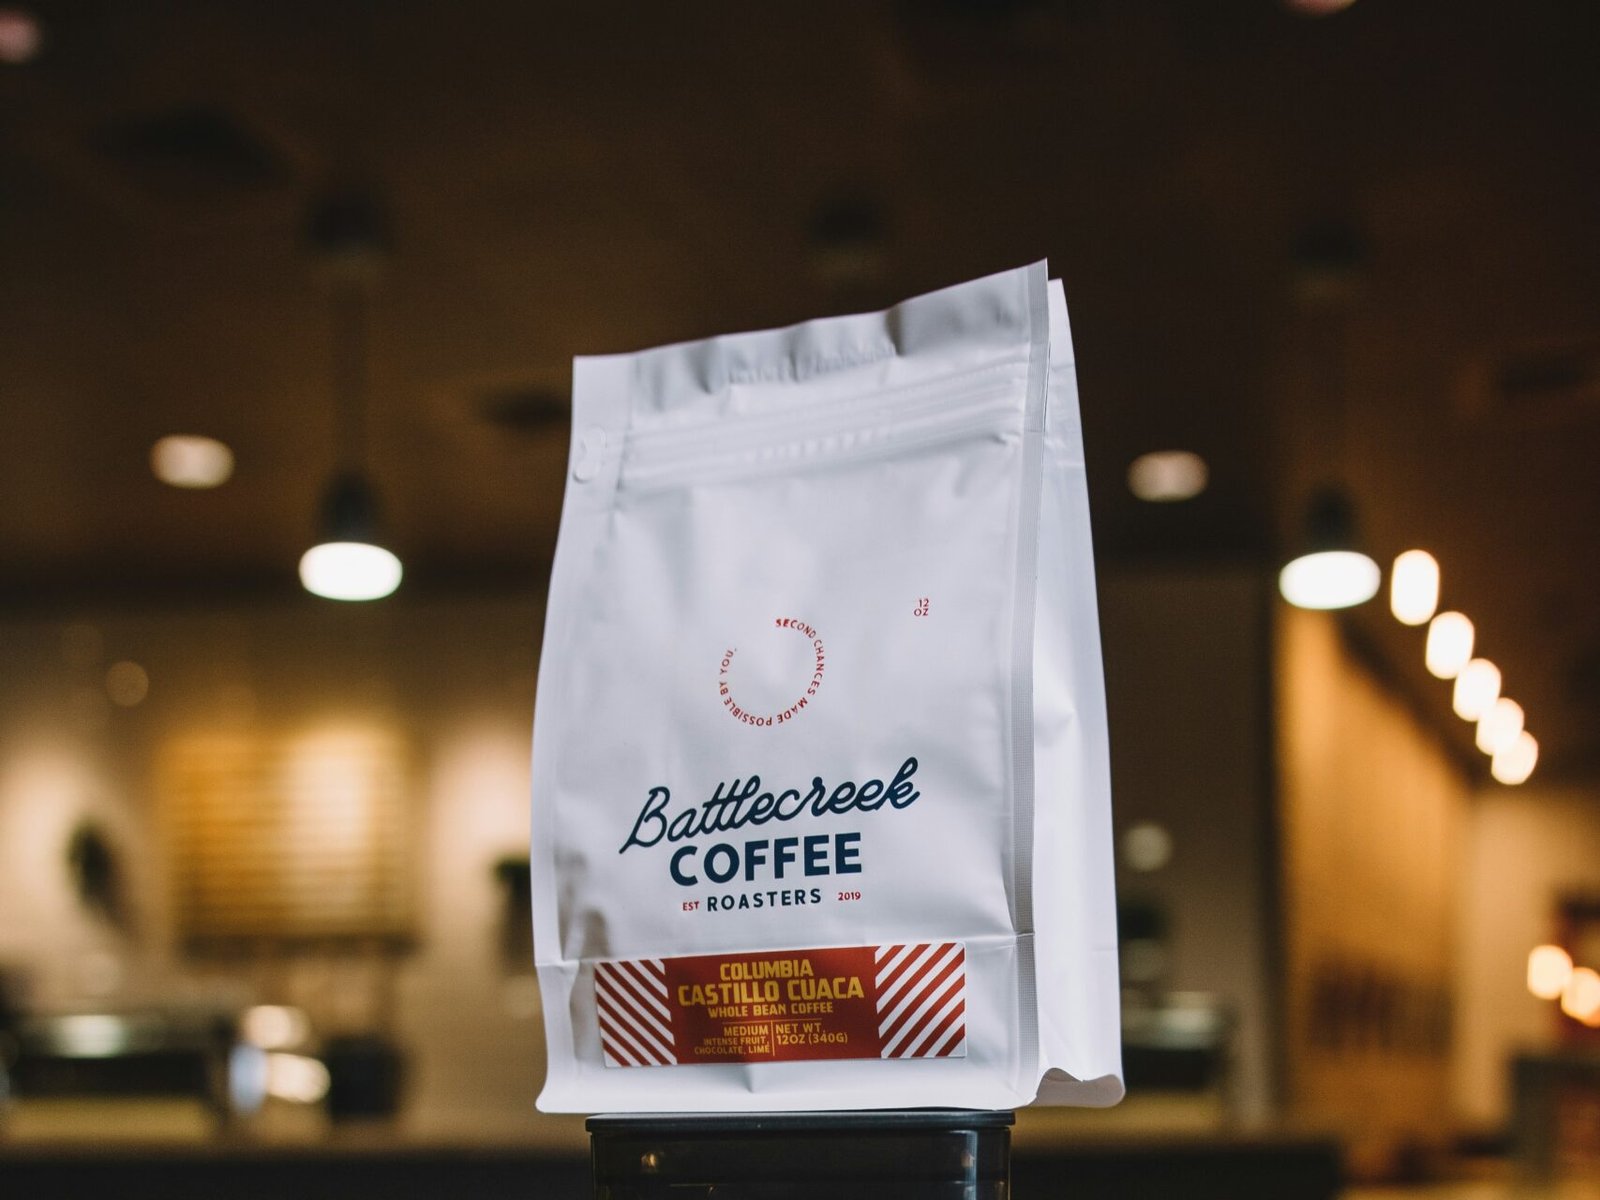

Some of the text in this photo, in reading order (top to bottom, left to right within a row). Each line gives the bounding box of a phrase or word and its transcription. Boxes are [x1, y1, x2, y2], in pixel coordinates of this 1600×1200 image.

[918, 598, 929, 607] 12
[913, 608, 929, 617] OZ
[775, 618, 816, 639] SECOND
[807, 639, 825, 696] CHANCES
[719, 681, 729, 696] BY
[723, 697, 773, 727] POSSIBLE
[777, 697, 808, 724] MADE
[618, 756, 921, 854] Battlecreek
[669, 832, 862, 887] COFFEE
[682, 888, 862, 912] EST ROASTERS 2019
[719, 958, 814, 982] COLUMBIA
[677, 976, 865, 1007] CASTILLO CUACA
[708, 1001, 834, 1019] WHOLE BEAN COFFEE
[723, 1024, 769, 1037] MEDIUM
[775, 1022, 799, 1035] NET
[776, 1031, 848, 1045] 12OZ (340G)
[703, 1036, 738, 1046] INTENSE
[748, 1044, 770, 1054] LIME
